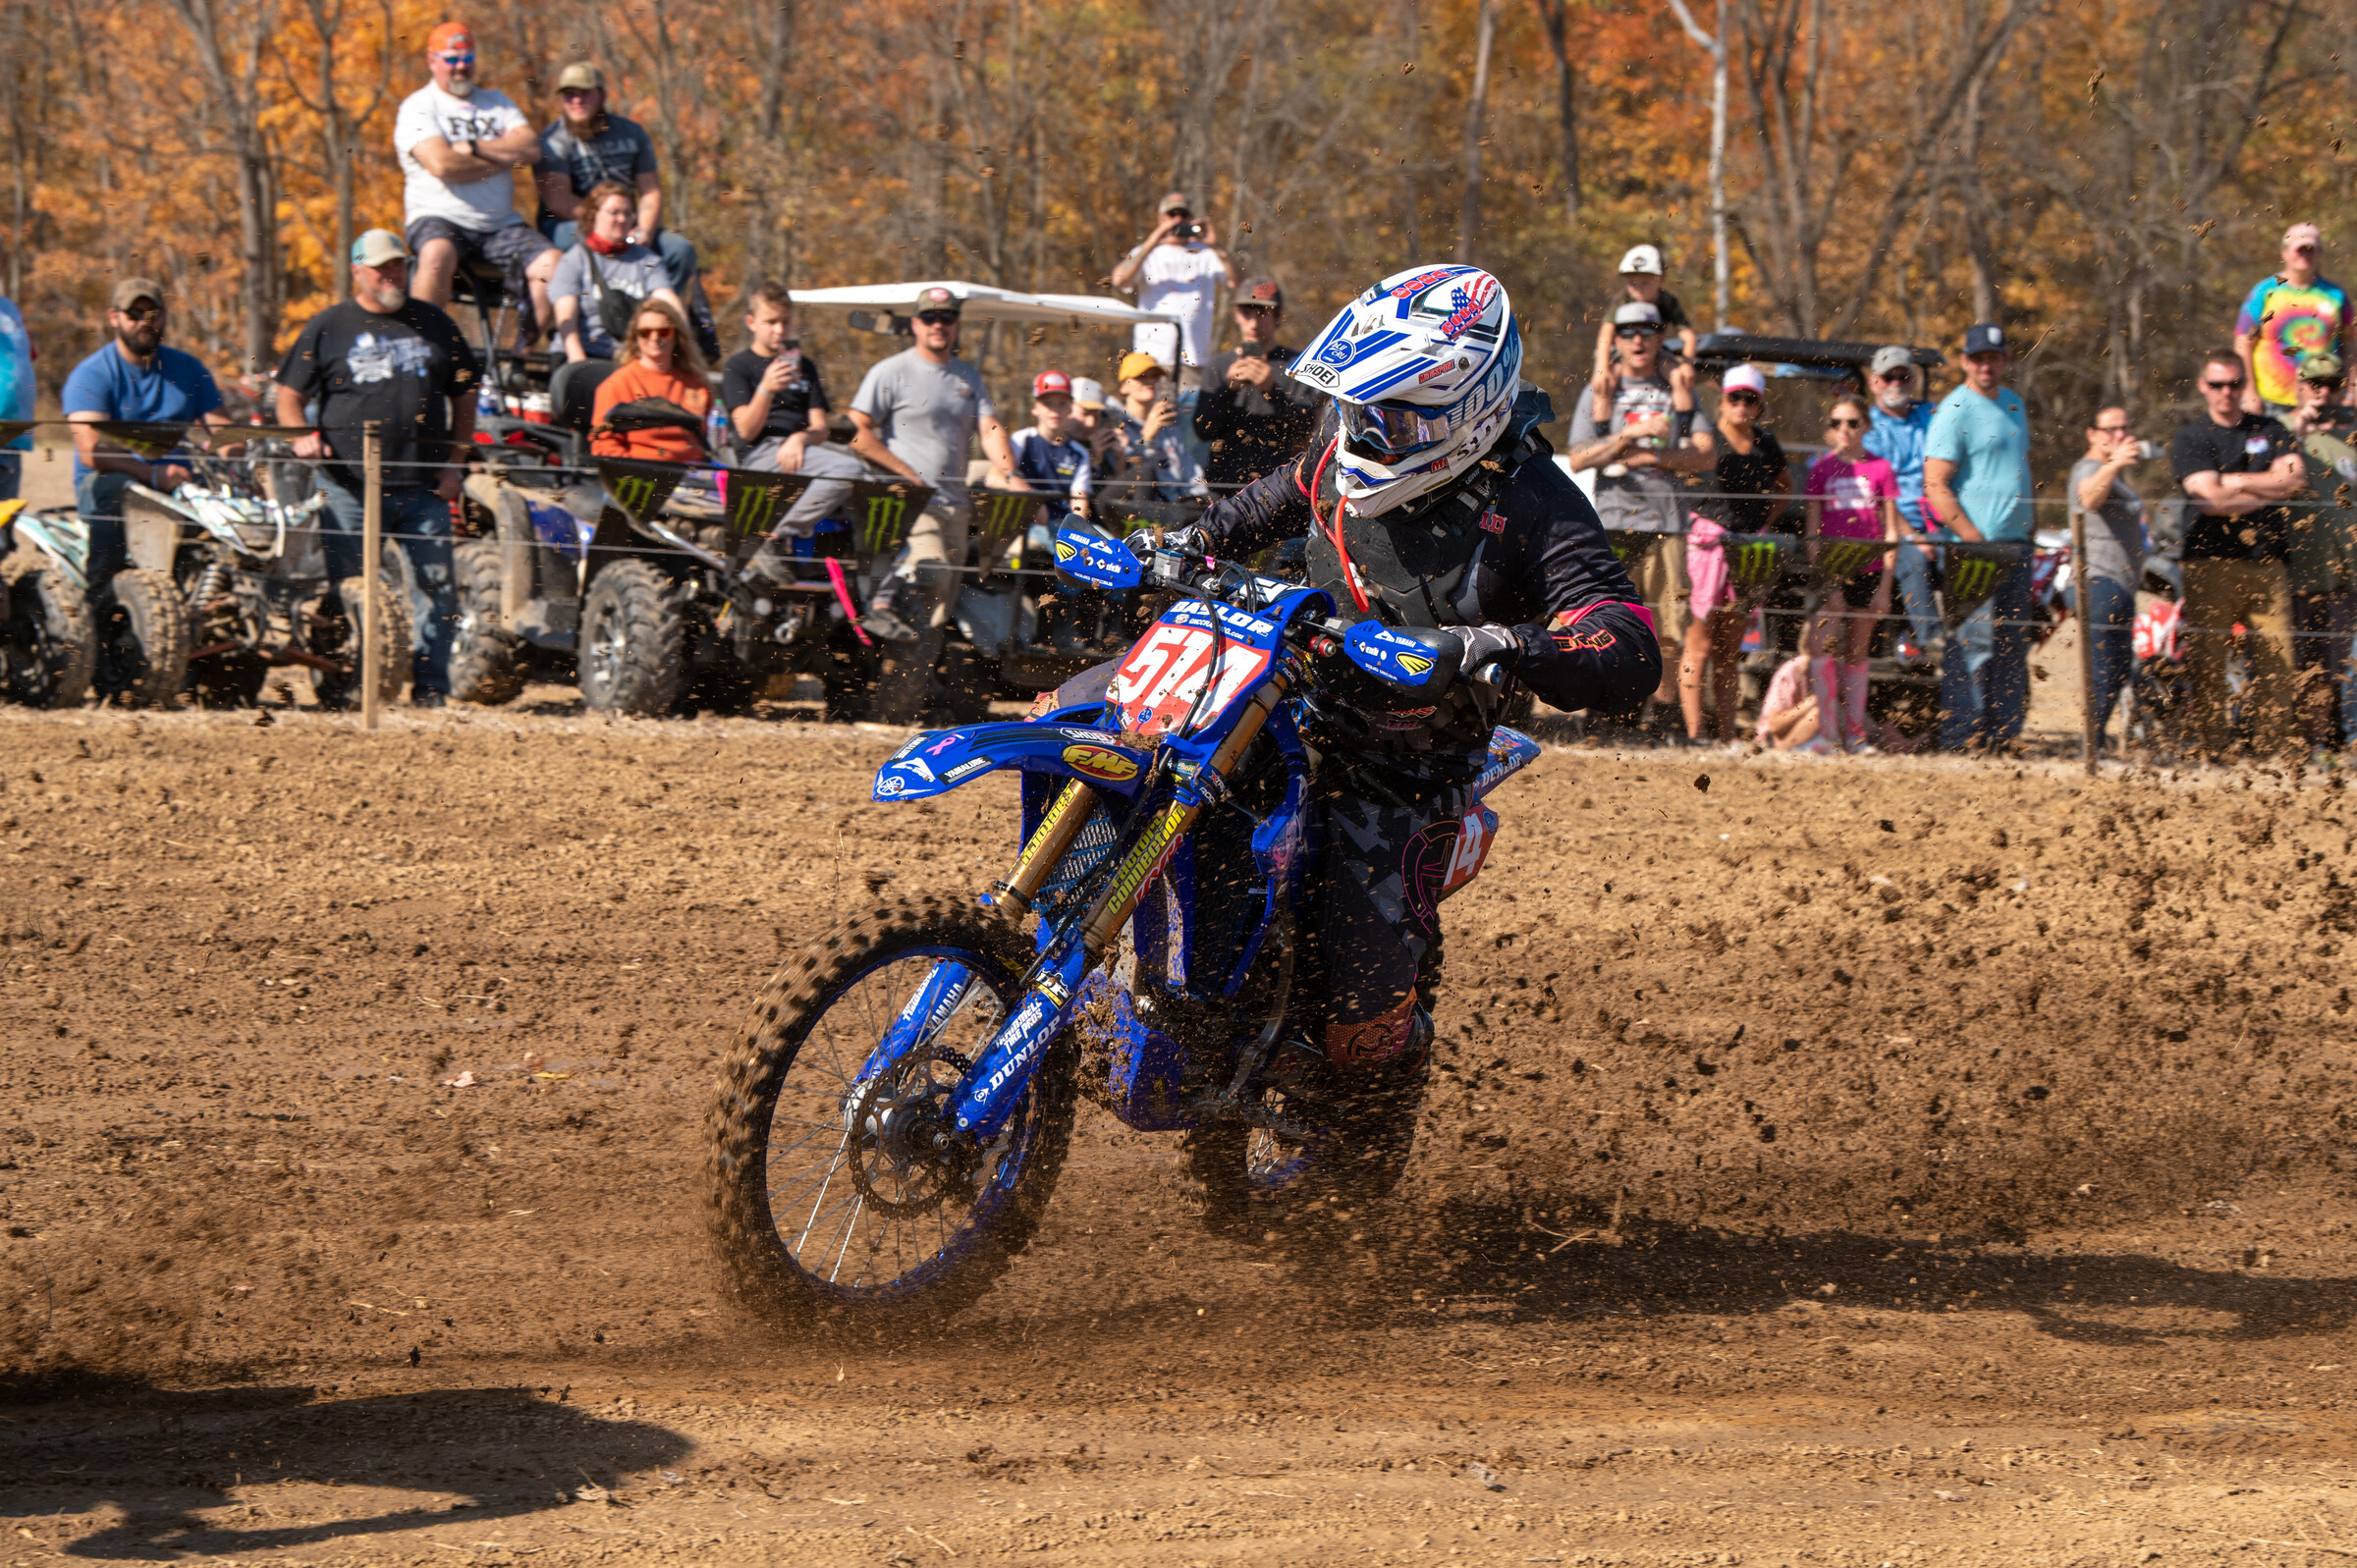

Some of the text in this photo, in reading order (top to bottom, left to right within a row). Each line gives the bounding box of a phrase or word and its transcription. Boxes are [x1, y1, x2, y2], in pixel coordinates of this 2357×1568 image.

[1441, 300, 1481, 334] COBA
[1300, 363, 1337, 385] SHOEI
[1446, 334, 1519, 432] 100%
[1069, 532, 1090, 546] YAMAHA
[1396, 636, 1417, 648] YAMAHA
[1106, 627, 1263, 726] 514
[944, 757, 987, 779] YAMALUBE
[1064, 747, 1139, 776] FMF
[1004, 1008, 1043, 1055] TIRE PROS
[989, 1015, 1061, 1092] DUNLOP
